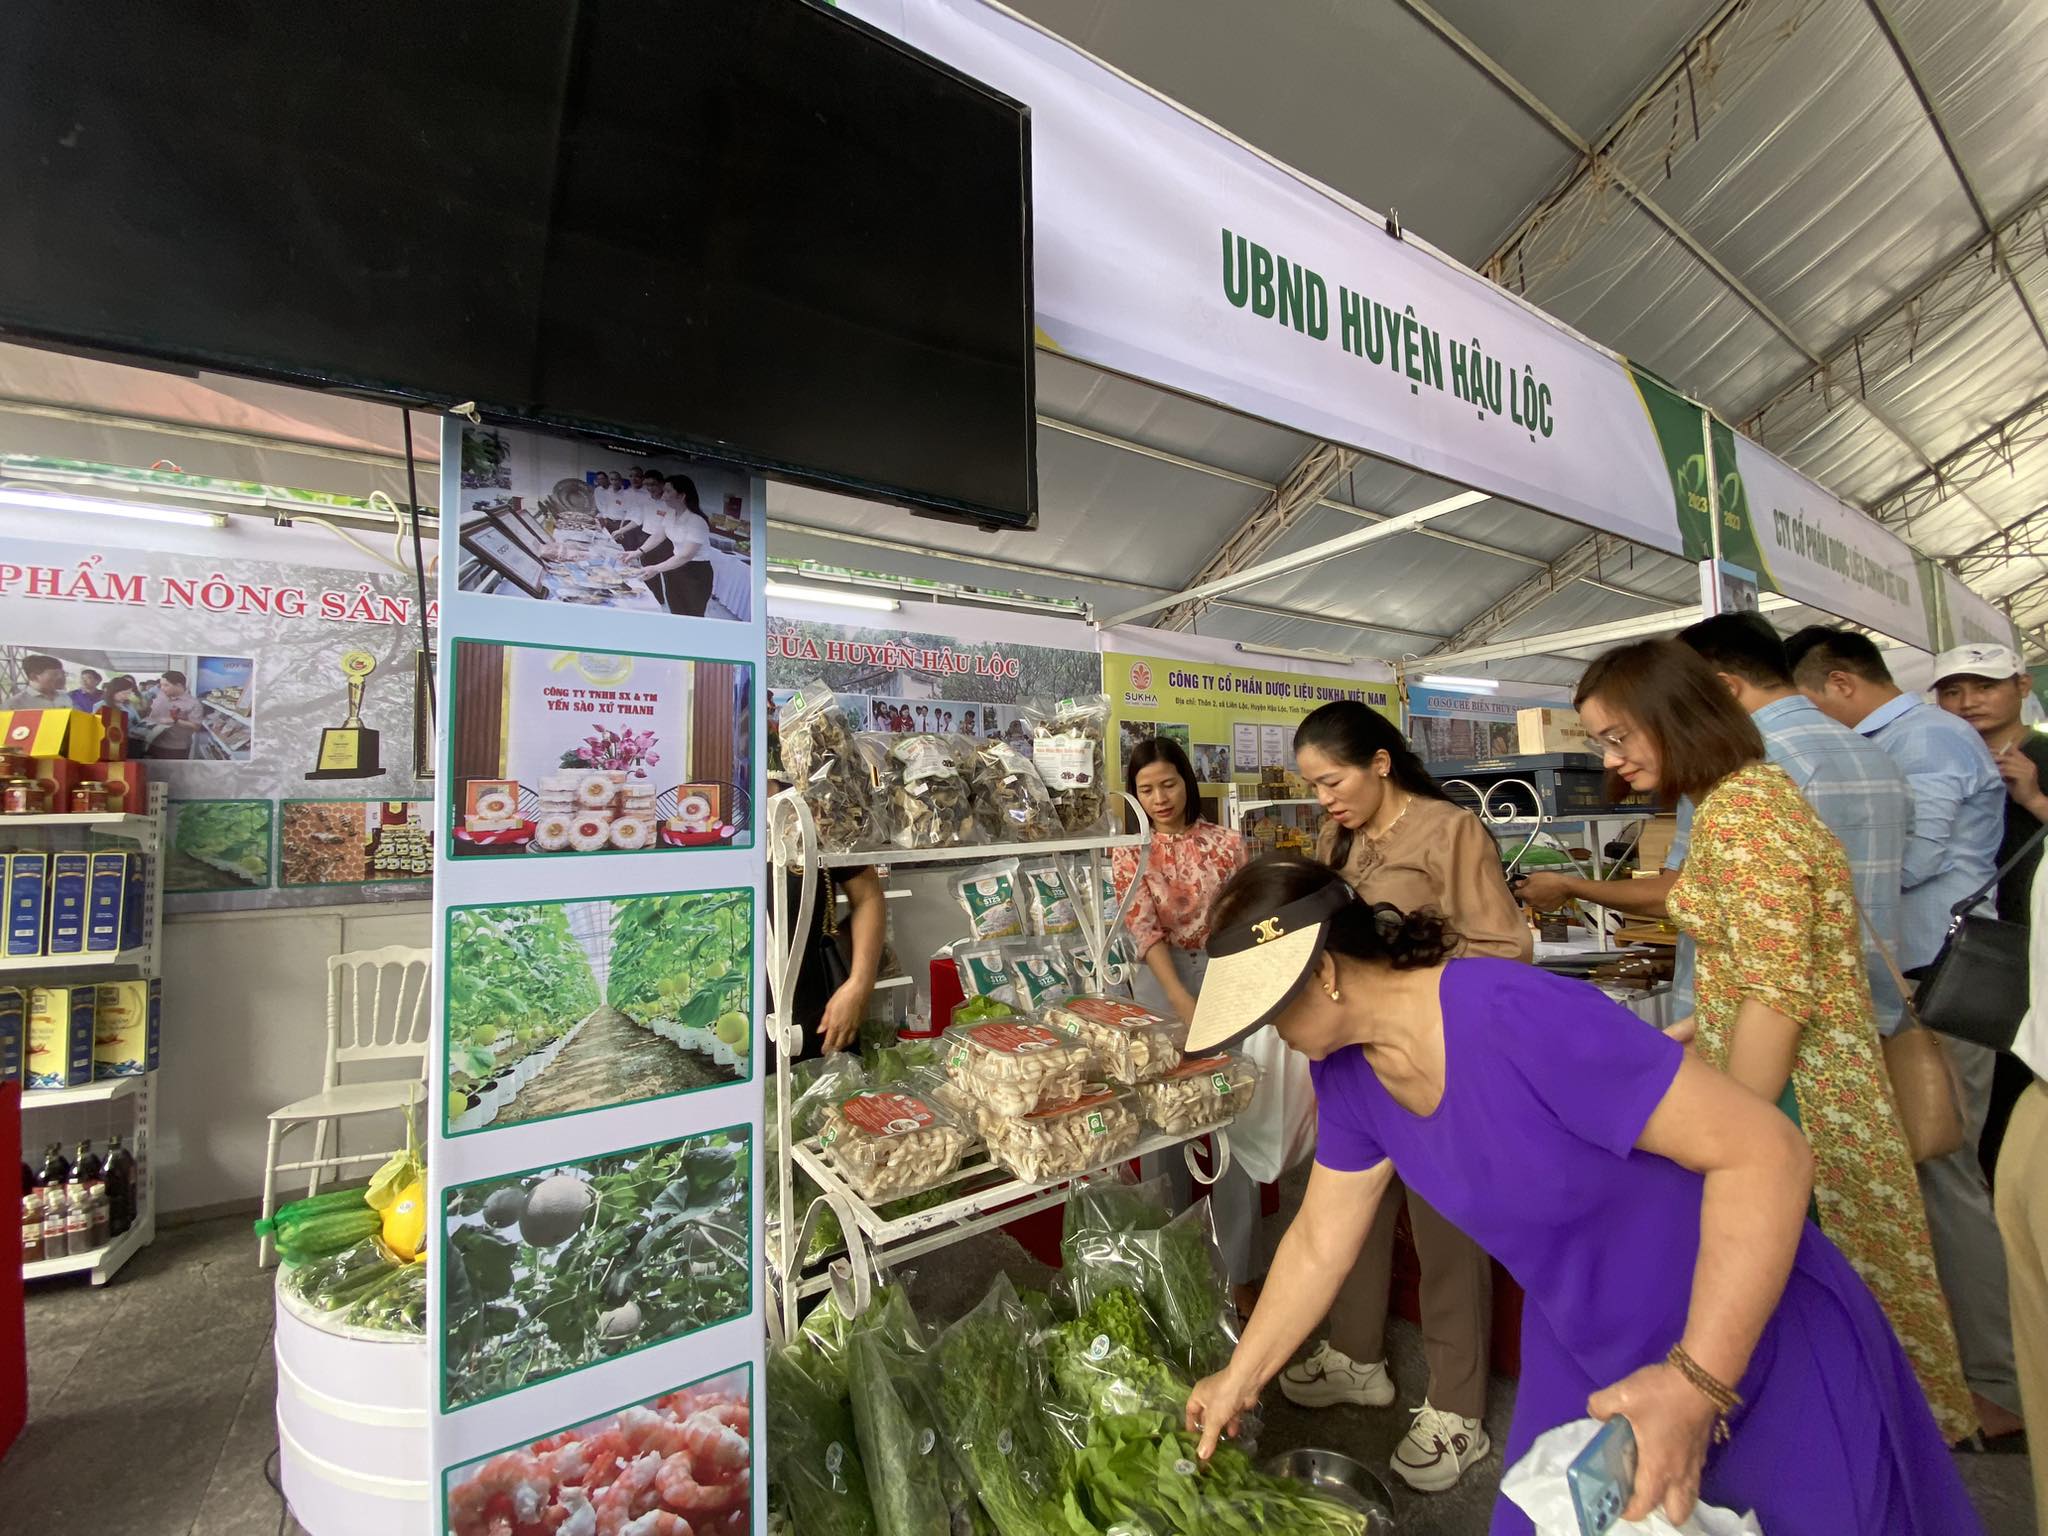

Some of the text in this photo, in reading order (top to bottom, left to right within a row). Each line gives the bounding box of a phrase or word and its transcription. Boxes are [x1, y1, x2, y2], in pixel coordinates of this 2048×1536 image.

[1221, 227, 1554, 443] UBND HUYỆN HẬU LỘC
[0, 554, 147, 603] PHẨM
[162, 573, 308, 617] NÔNG
[320, 584, 410, 624] SẢN
[826, 640, 915, 671] HUYỆN
[923, 648, 970, 676] HẬU
[976, 652, 1019, 681] LỘC
[543, 686, 658, 702] CÔNG TY TNHH SX & TM
[1125, 692, 1158, 702] SUKHA
[1168, 669, 1199, 689] CÔNG
[1202, 675, 1215, 691] TY
[1218, 673, 1232, 692] CỔ
[1235, 675, 1263, 695] PHẦN
[1265, 681, 1291, 700] DƯỢC
[1293, 683, 1314, 702] LIỆU
[1316, 687, 1345, 701] SUKHA
[1368, 692, 1387, 706] NAM
[547, 698, 570, 711] YẾN
[573, 700, 595, 712] SÀO
[617, 704, 654, 715] THANH
